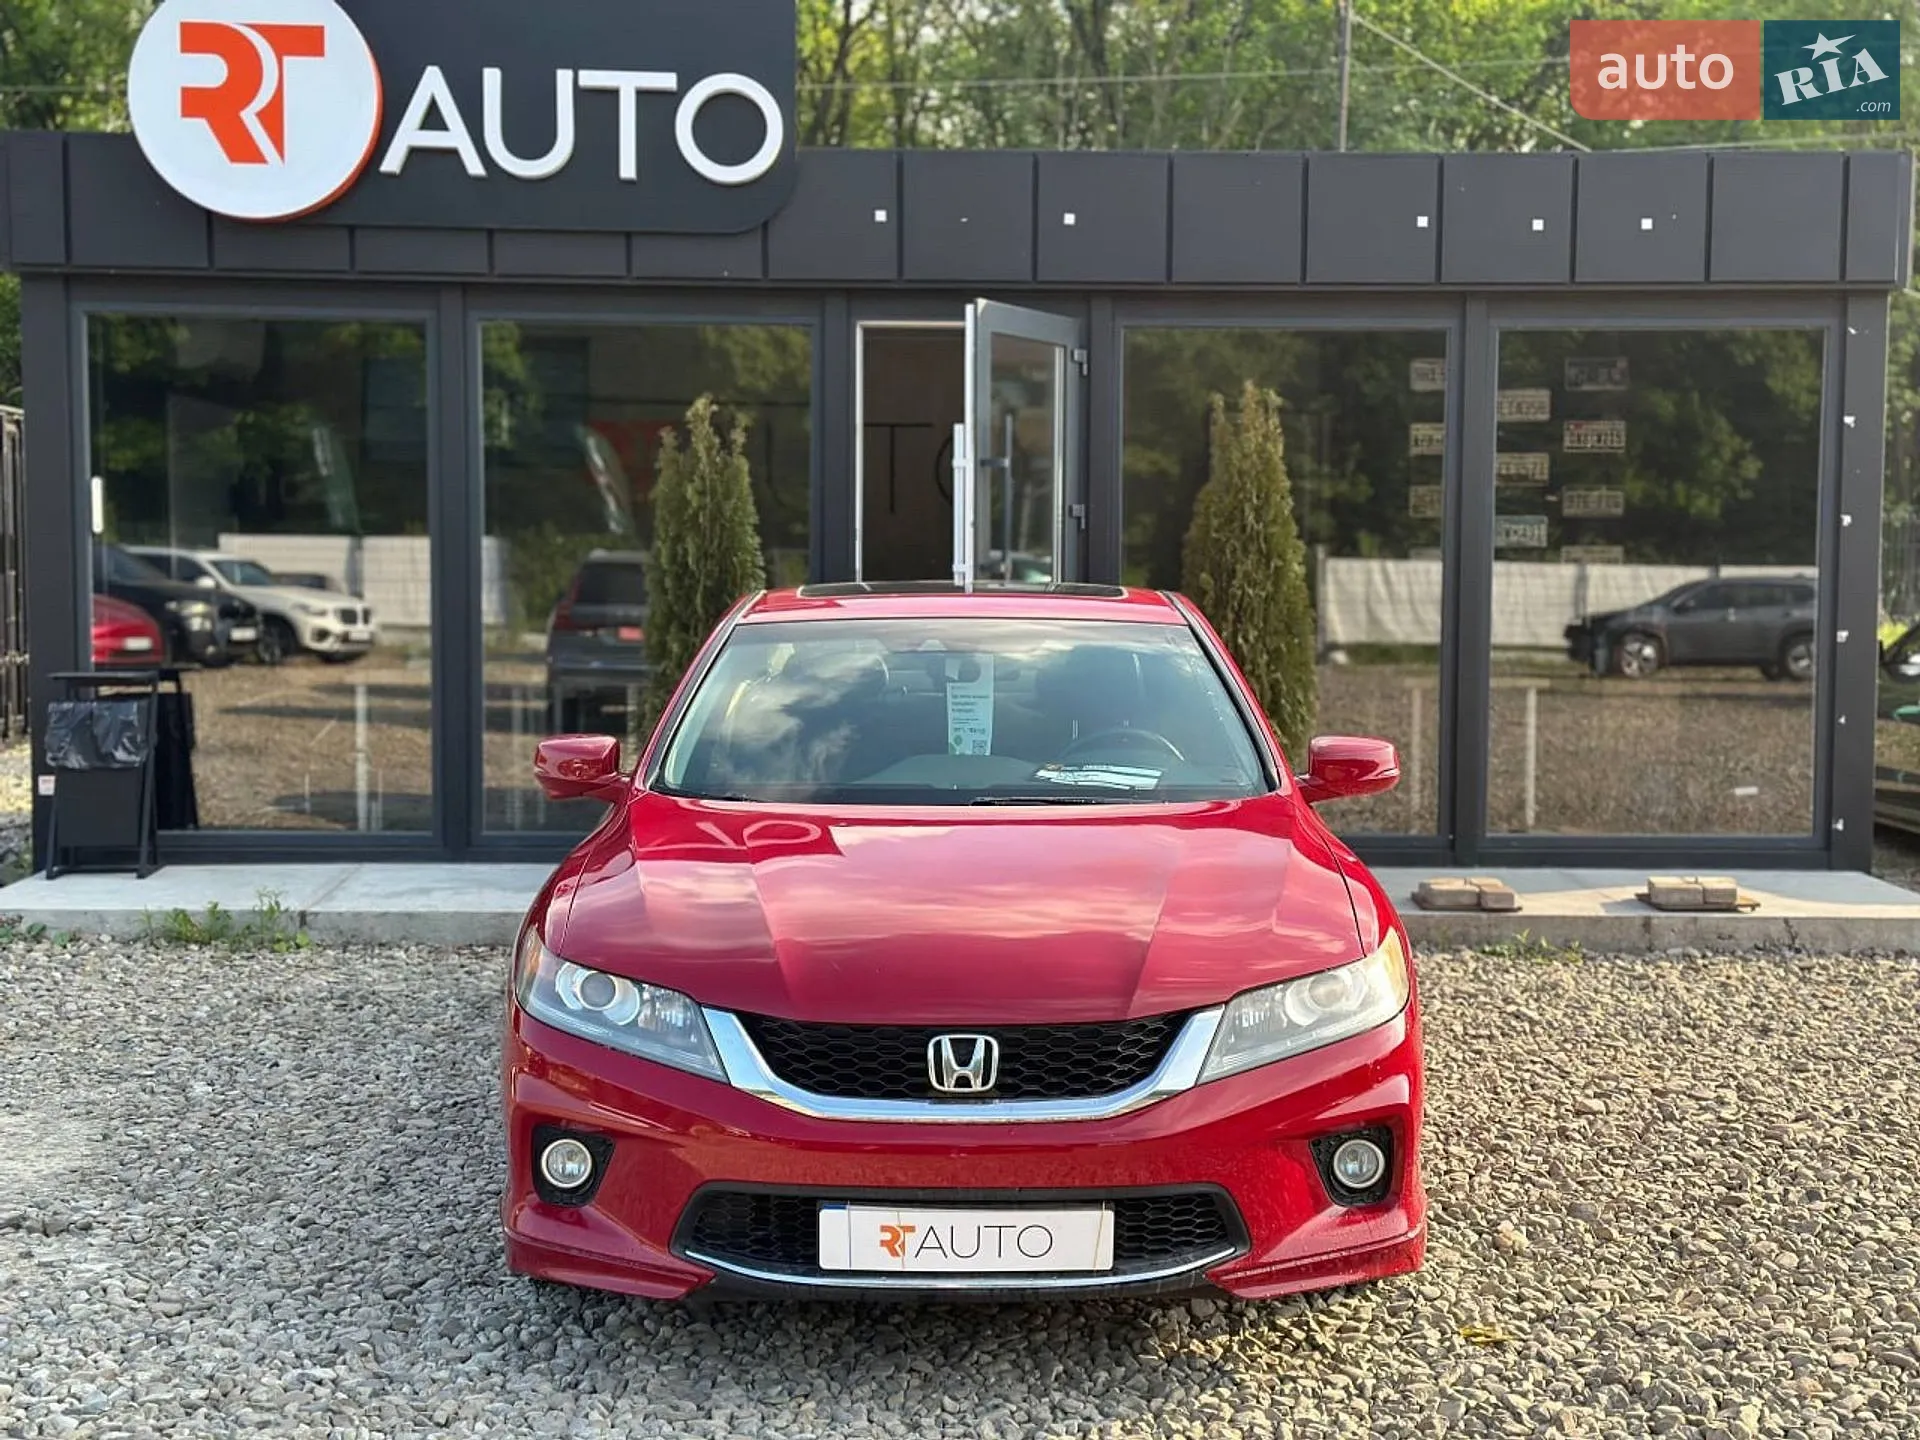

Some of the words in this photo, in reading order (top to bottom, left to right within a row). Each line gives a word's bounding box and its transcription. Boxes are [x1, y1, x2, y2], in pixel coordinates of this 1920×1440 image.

[179, 21, 325, 166] RT
[379, 65, 784, 185] AUTO
[915, 1224, 1053, 1259] AUTO
